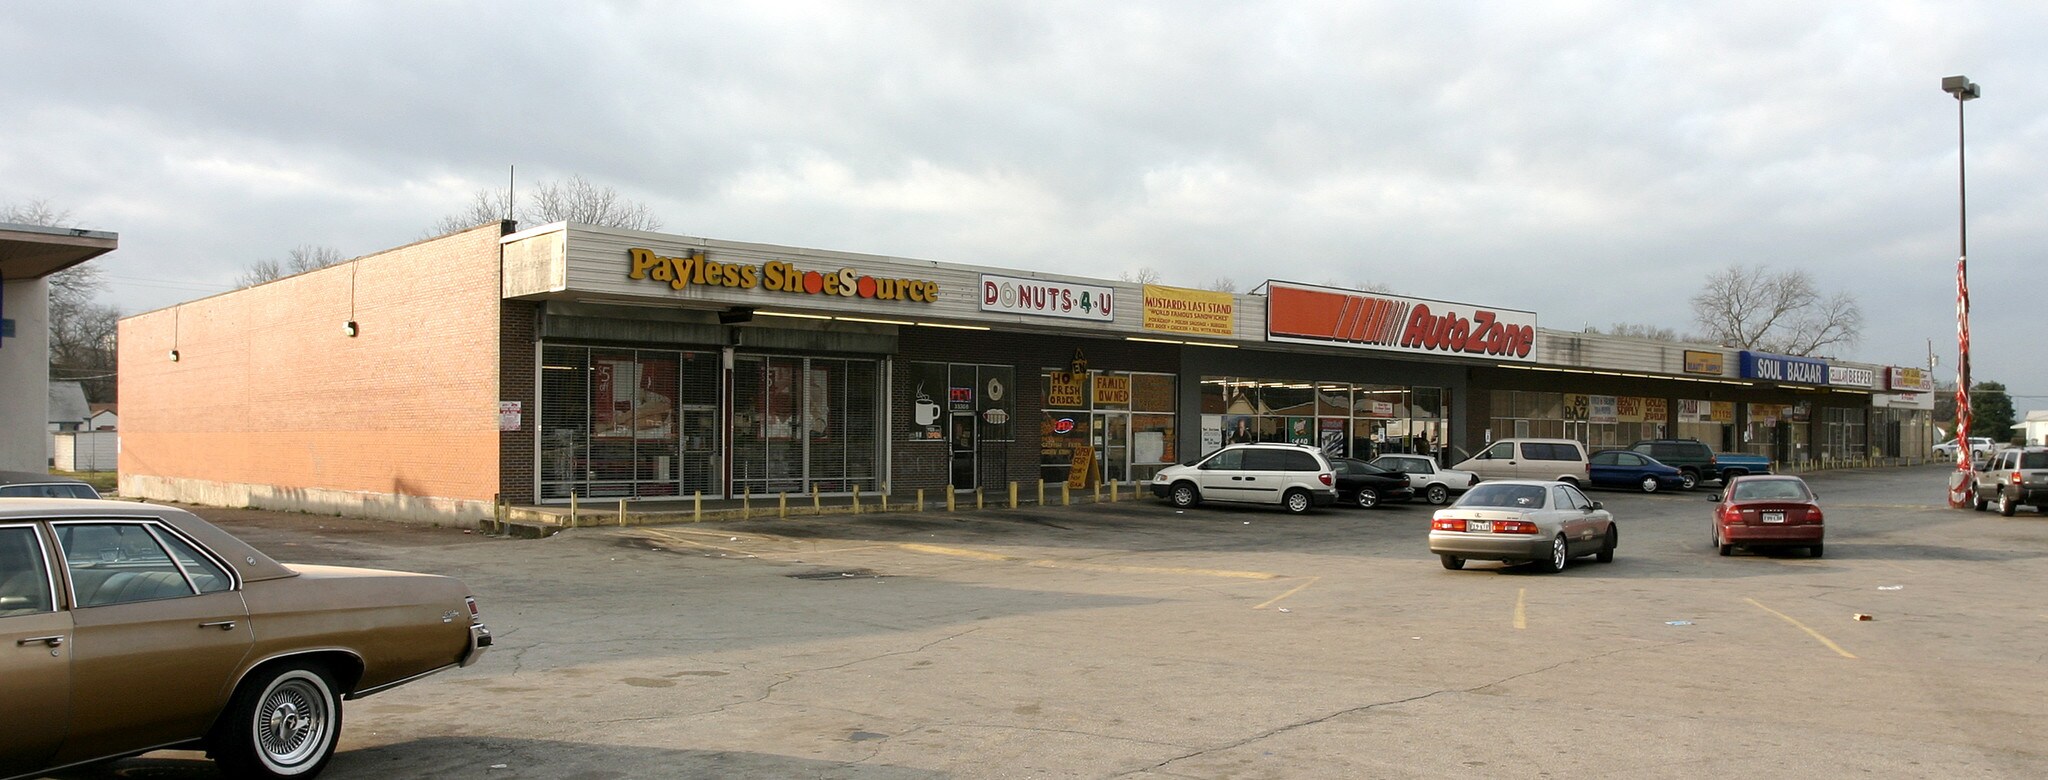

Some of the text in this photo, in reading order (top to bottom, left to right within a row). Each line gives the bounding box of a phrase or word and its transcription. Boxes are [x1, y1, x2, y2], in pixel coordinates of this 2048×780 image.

[629, 248, 757, 290] Payless
[1145, 297, 1232, 315] MUSTARDS LAST STAND
[1401, 304, 1534, 358] AutoZone
[1758, 358, 1822, 384] SOUL BAZAAR
[1848, 370, 1873, 384] BEEPER
[1097, 377, 1127, 390] FAMILY
[1052, 386, 1080, 395] FRESH
[1099, 390, 1128, 402] OWNED
[1049, 396, 1082, 405] ORDERS
[1617, 398, 1640, 408] BEAUTY
